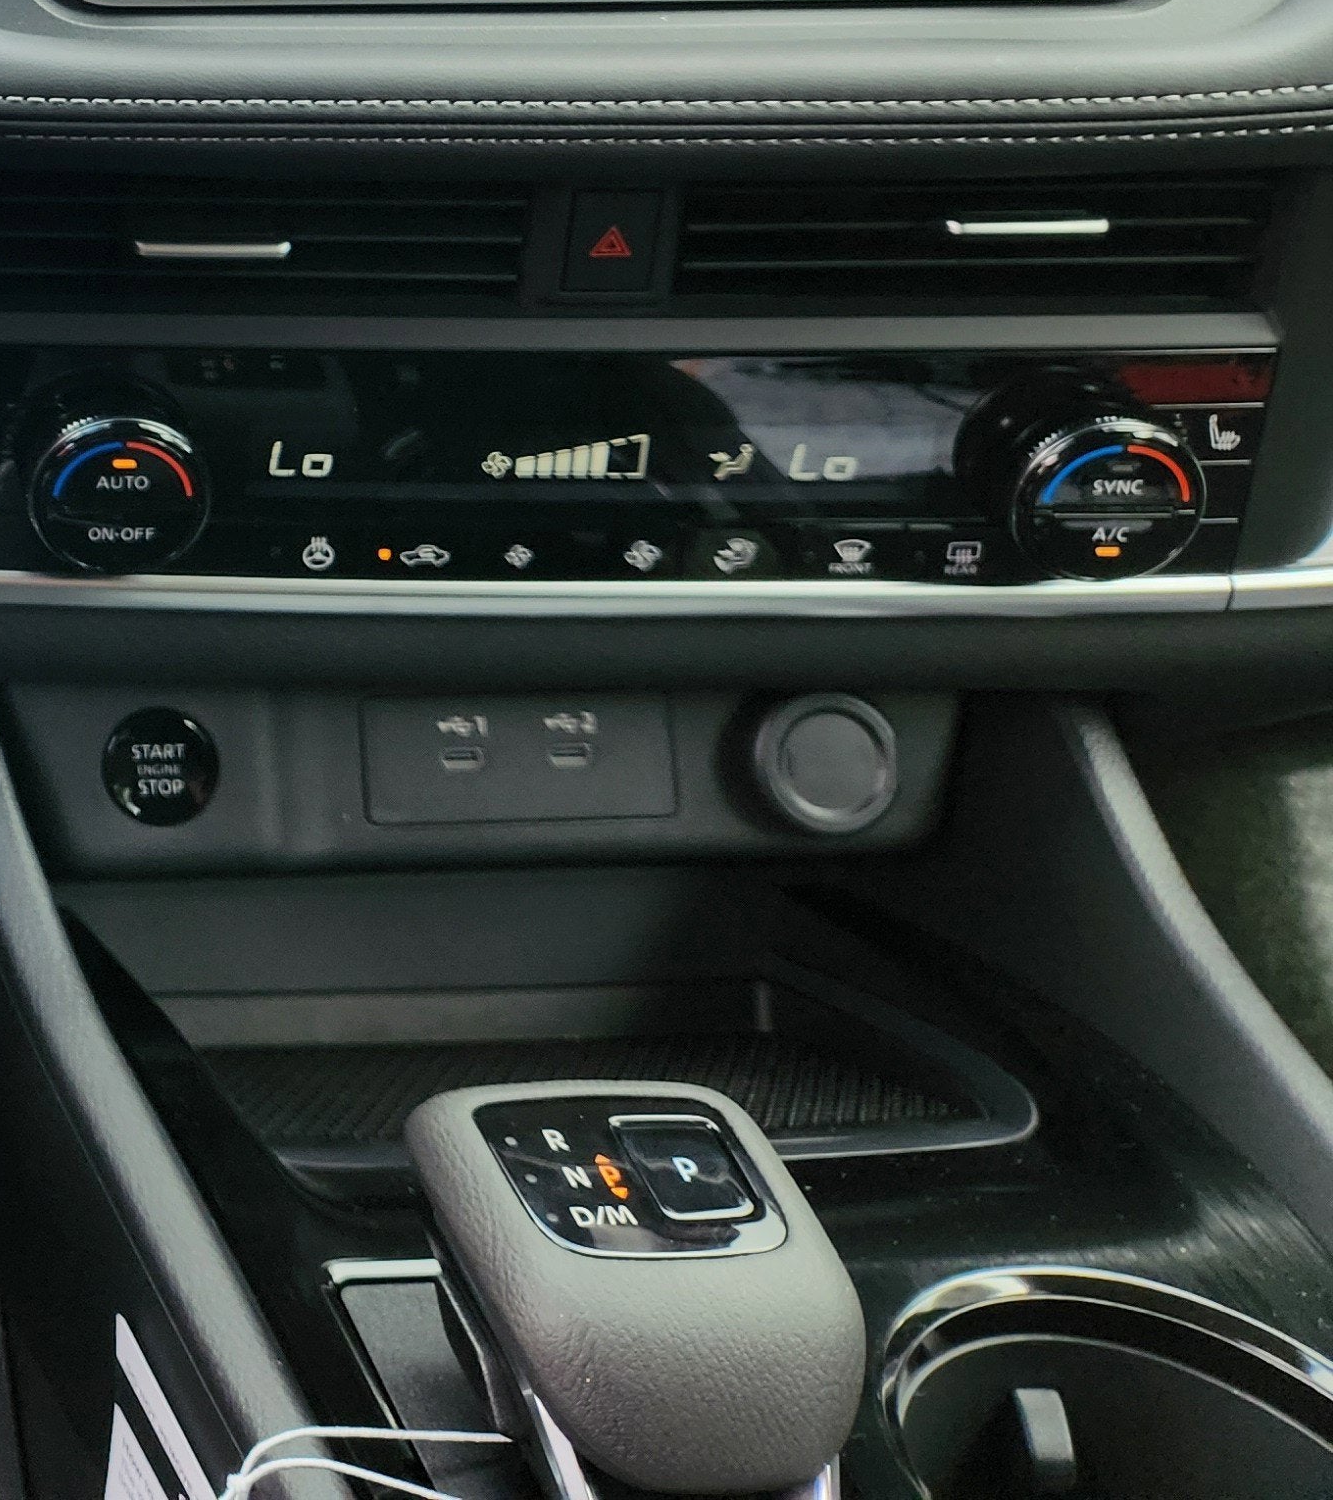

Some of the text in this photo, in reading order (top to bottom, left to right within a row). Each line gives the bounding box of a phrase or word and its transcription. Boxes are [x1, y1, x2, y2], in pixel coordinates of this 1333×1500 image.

[268, 441, 333, 478] Lo
[789, 443, 858, 481] Lo
[97, 475, 149, 491] AUTO
[1093, 478, 1144, 496] SYNC
[1092, 526, 1130, 544] A/C
[131, 743, 185, 759] START
[137, 778, 185, 797] STOP
[541, 1127, 571, 1153] R
[561, 1165, 593, 1190] N
[597, 1163, 623, 1188] P
[671, 1156, 699, 1183] P
[568, 1204, 639, 1228] D/M
